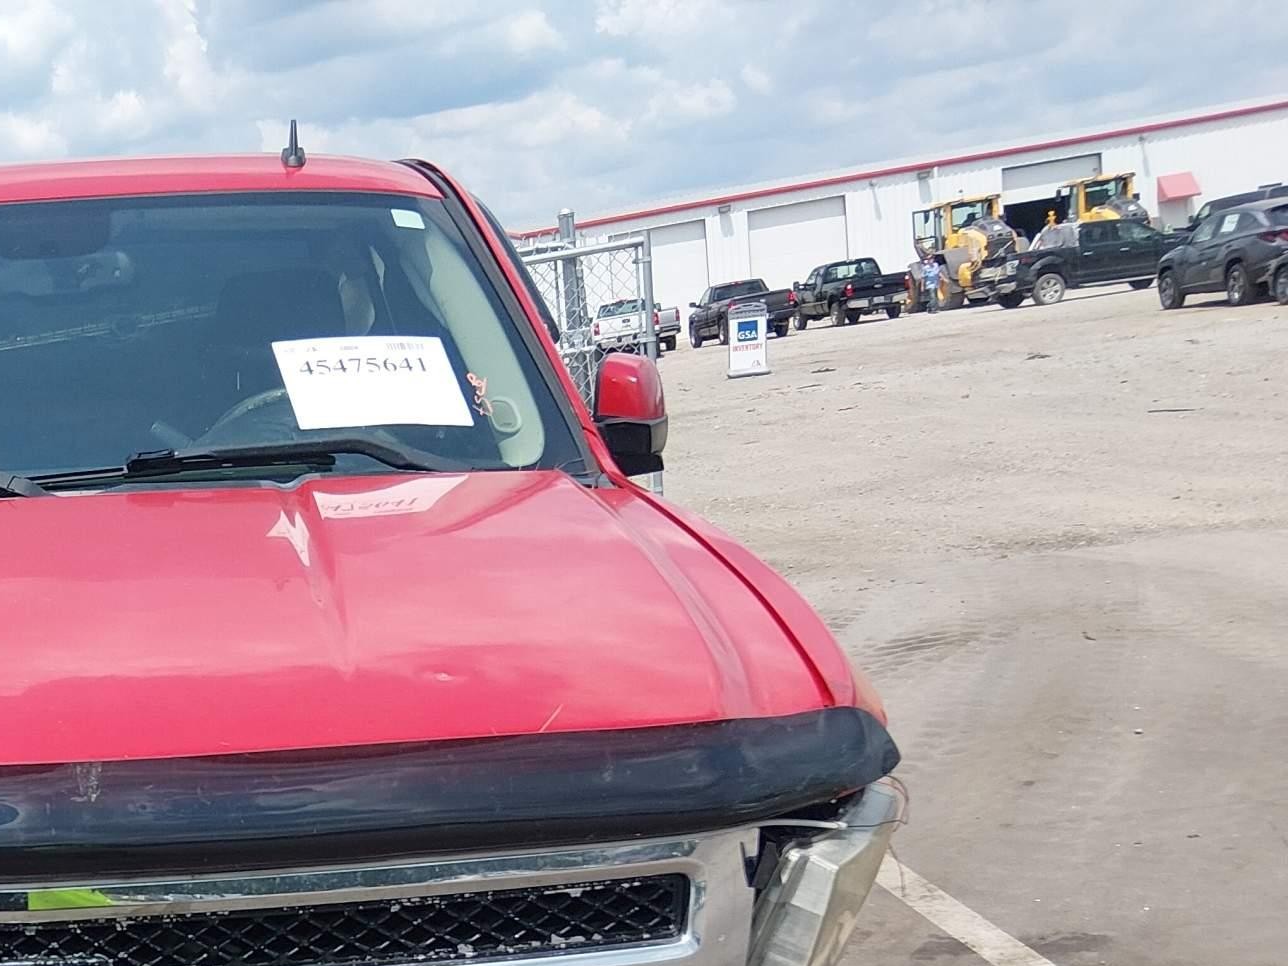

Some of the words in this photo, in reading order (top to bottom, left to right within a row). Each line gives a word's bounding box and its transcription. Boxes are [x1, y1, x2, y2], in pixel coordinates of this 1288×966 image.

[738, 330, 757, 340] GSA
[732, 343, 763, 352] INVENTORY
[299, 357, 427, 375] 45475641
